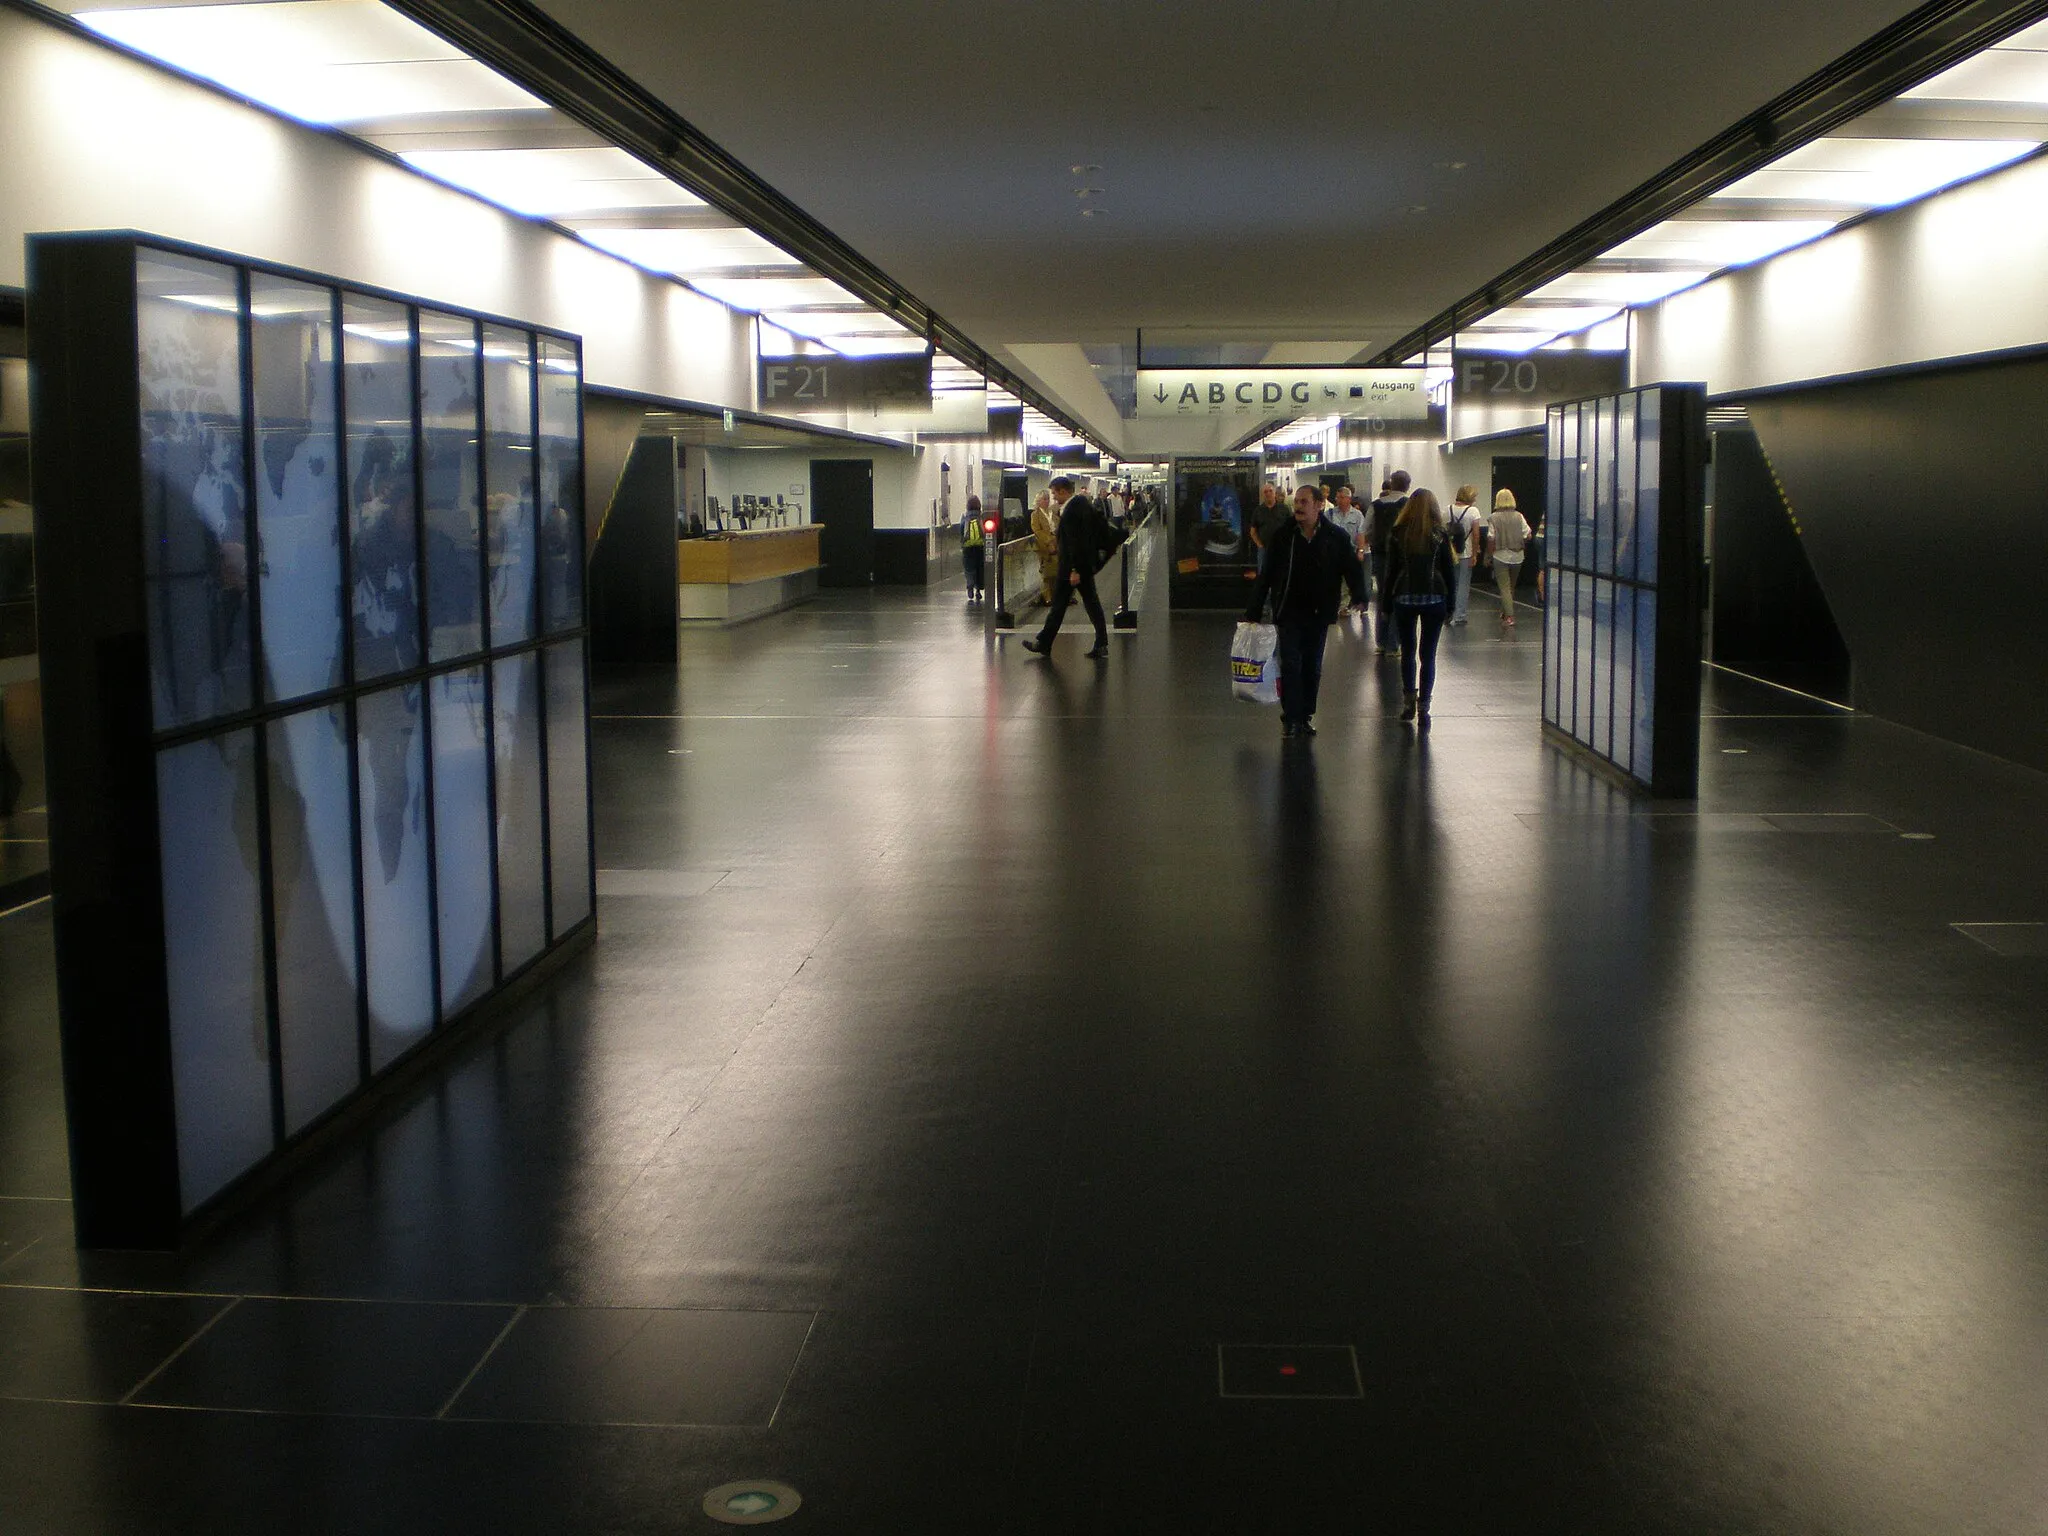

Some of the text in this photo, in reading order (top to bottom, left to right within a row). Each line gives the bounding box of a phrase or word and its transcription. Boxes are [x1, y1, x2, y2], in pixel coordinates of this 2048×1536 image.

[766, 365, 828, 399] F21
[1371, 381, 1415, 392] Ausgang
[1462, 360, 1538, 393] F20
[1178, 382, 1309, 404] A B C D G
[1371, 393, 1388, 401] exit
